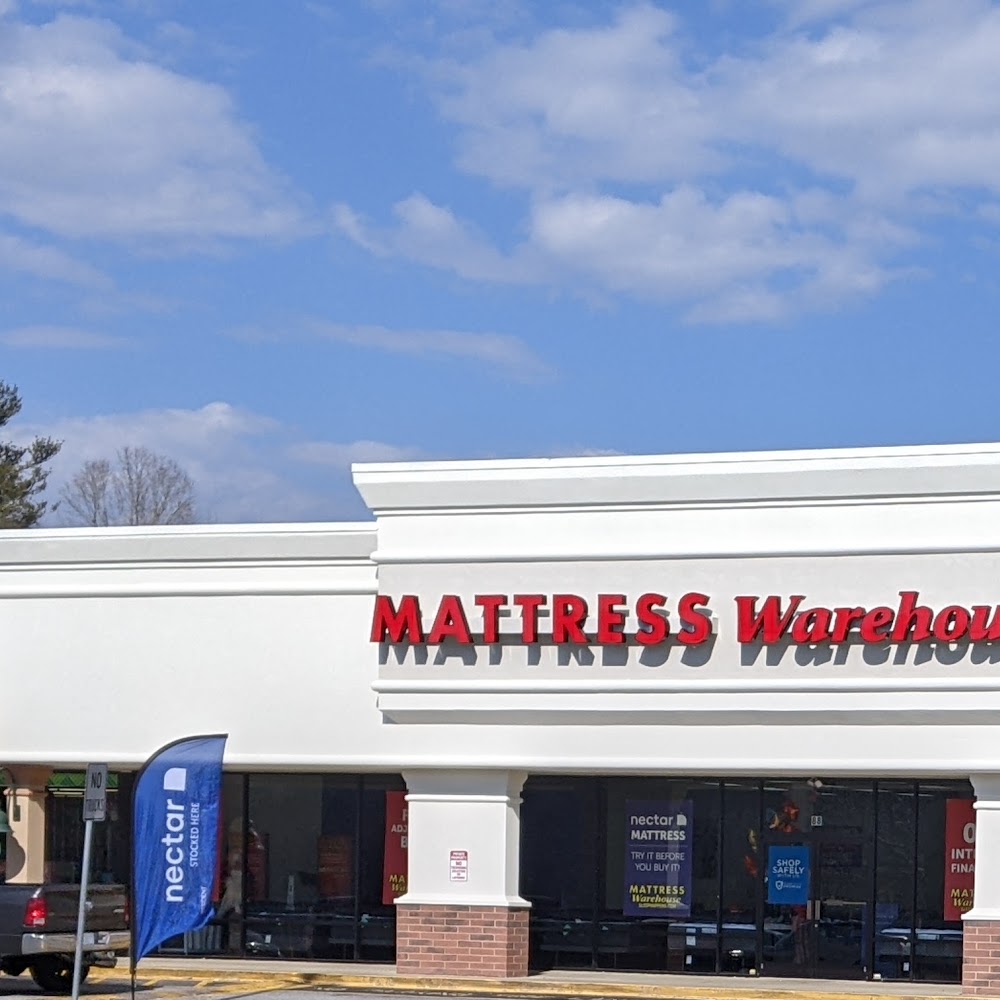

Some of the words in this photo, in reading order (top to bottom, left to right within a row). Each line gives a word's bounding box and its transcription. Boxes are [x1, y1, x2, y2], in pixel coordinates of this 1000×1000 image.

[370, 592, 713, 645] MATTRESS
[91, 771, 102, 789] NO
[191, 803, 200, 826] HERE
[630, 814, 674, 826] nectar
[631, 829, 686, 841] MATTRESS
[162, 799, 185, 903] nectar
[190, 828, 199, 867] STOCKED
[631, 851, 645, 860] TRY
[647, 852, 654, 860] IT
[656, 852, 685, 861] BEFORE
[951, 848, 976, 860] INT
[635, 863, 651, 871] YOU
[654, 864, 670, 872] BUY
[776, 859, 801, 867] SHOP
[772, 866, 805, 875] SAFELY
[629, 885, 685, 895] MATTRESS
[632, 894, 682, 904] Warehouse
